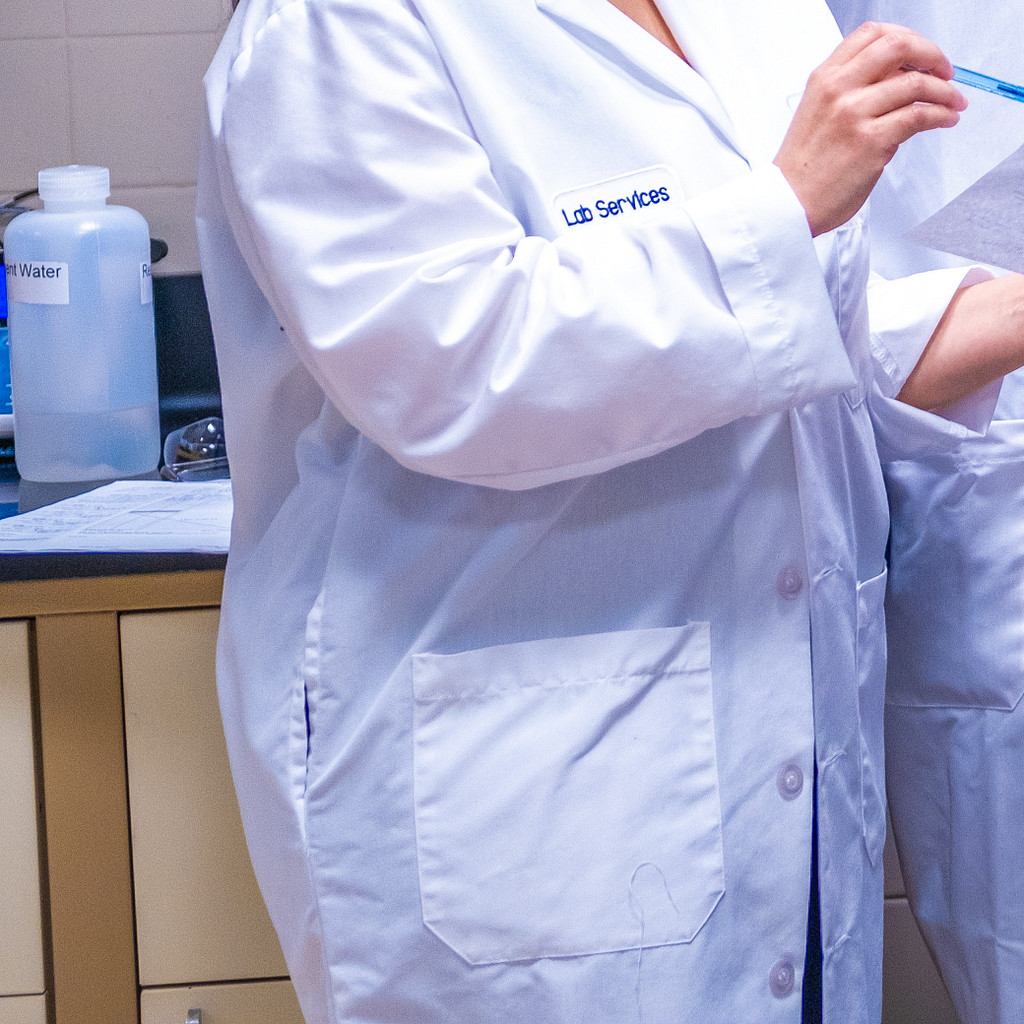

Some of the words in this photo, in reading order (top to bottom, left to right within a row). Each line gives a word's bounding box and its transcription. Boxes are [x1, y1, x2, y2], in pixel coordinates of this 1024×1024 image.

[562, 204, 594, 227] Lab
[595, 186, 671, 219] Services
[19, 263, 62, 279] Water
